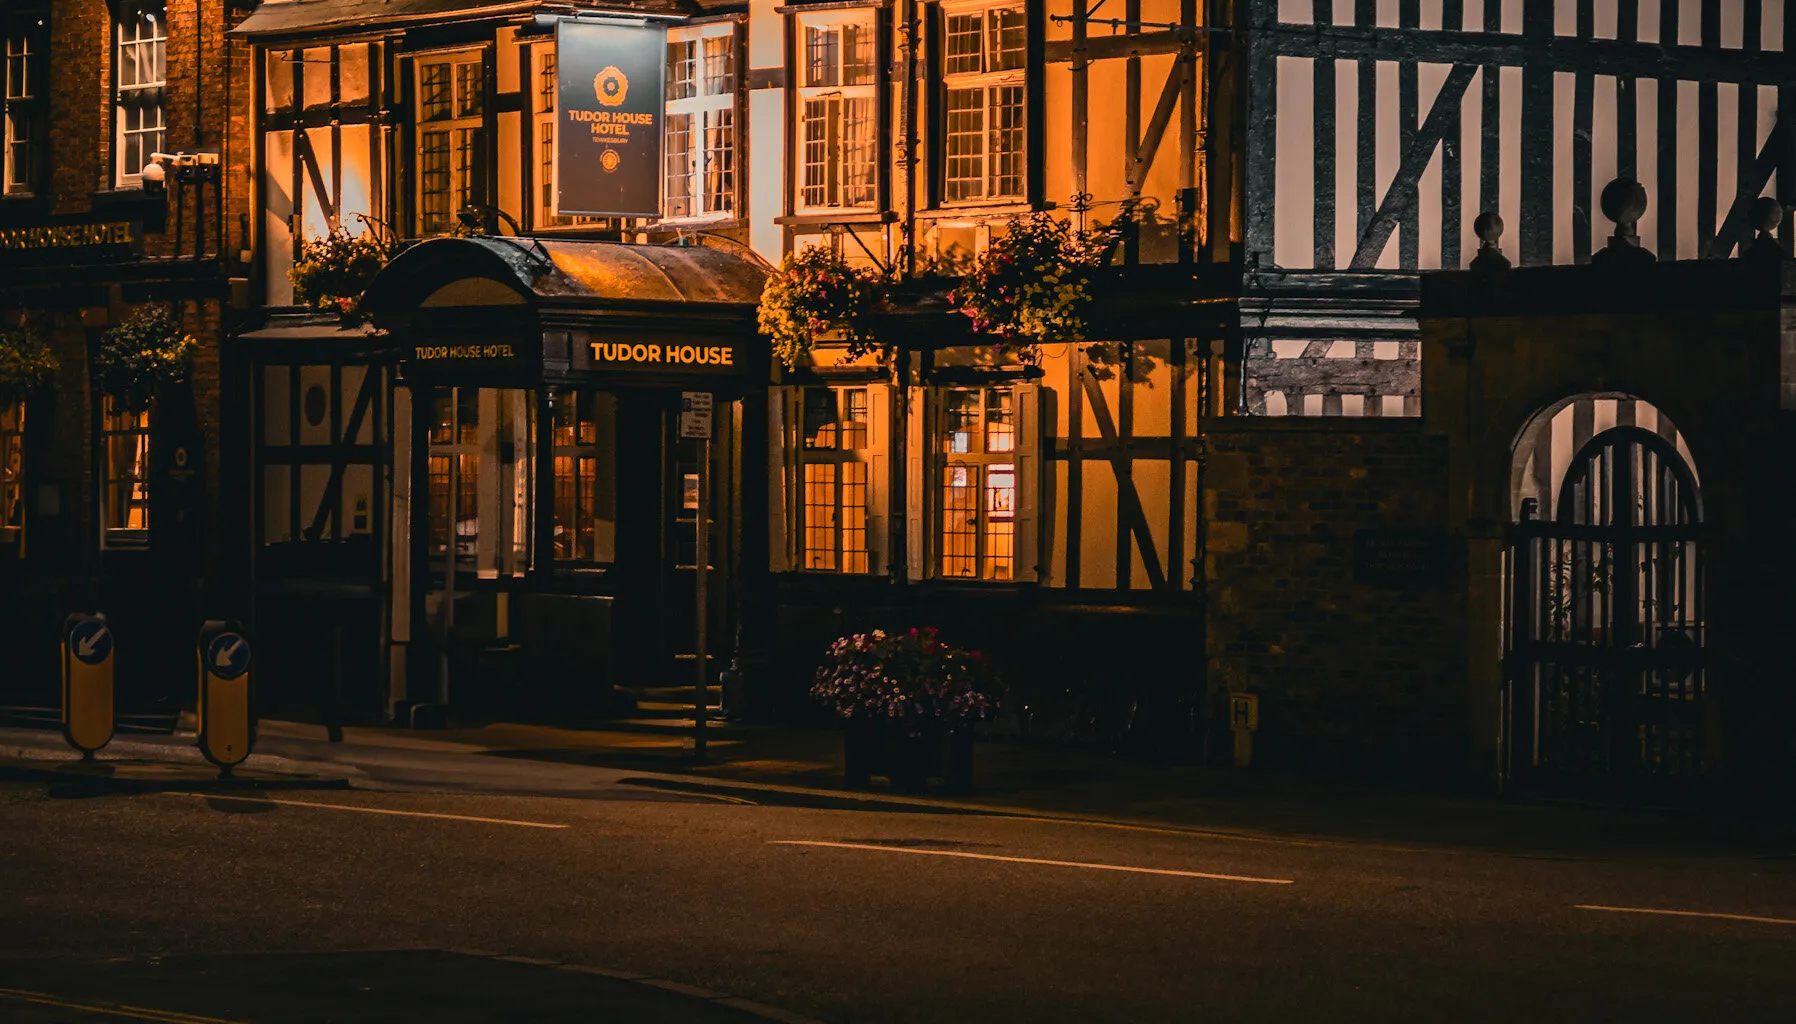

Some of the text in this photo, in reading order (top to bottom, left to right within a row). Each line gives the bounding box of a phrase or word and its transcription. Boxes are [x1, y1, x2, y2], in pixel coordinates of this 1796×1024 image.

[568, 110, 653, 125] TUDOR HOUSE
[591, 123, 630, 135] HOTEL
[28, 225, 82, 248] HOUSE
[82, 221, 134, 245] HOTEL
[415, 344, 514, 360] TUDOR HOUSE HOTEL
[590, 342, 734, 366] TUDOR HOUSE
[1234, 700, 1249, 725] H
